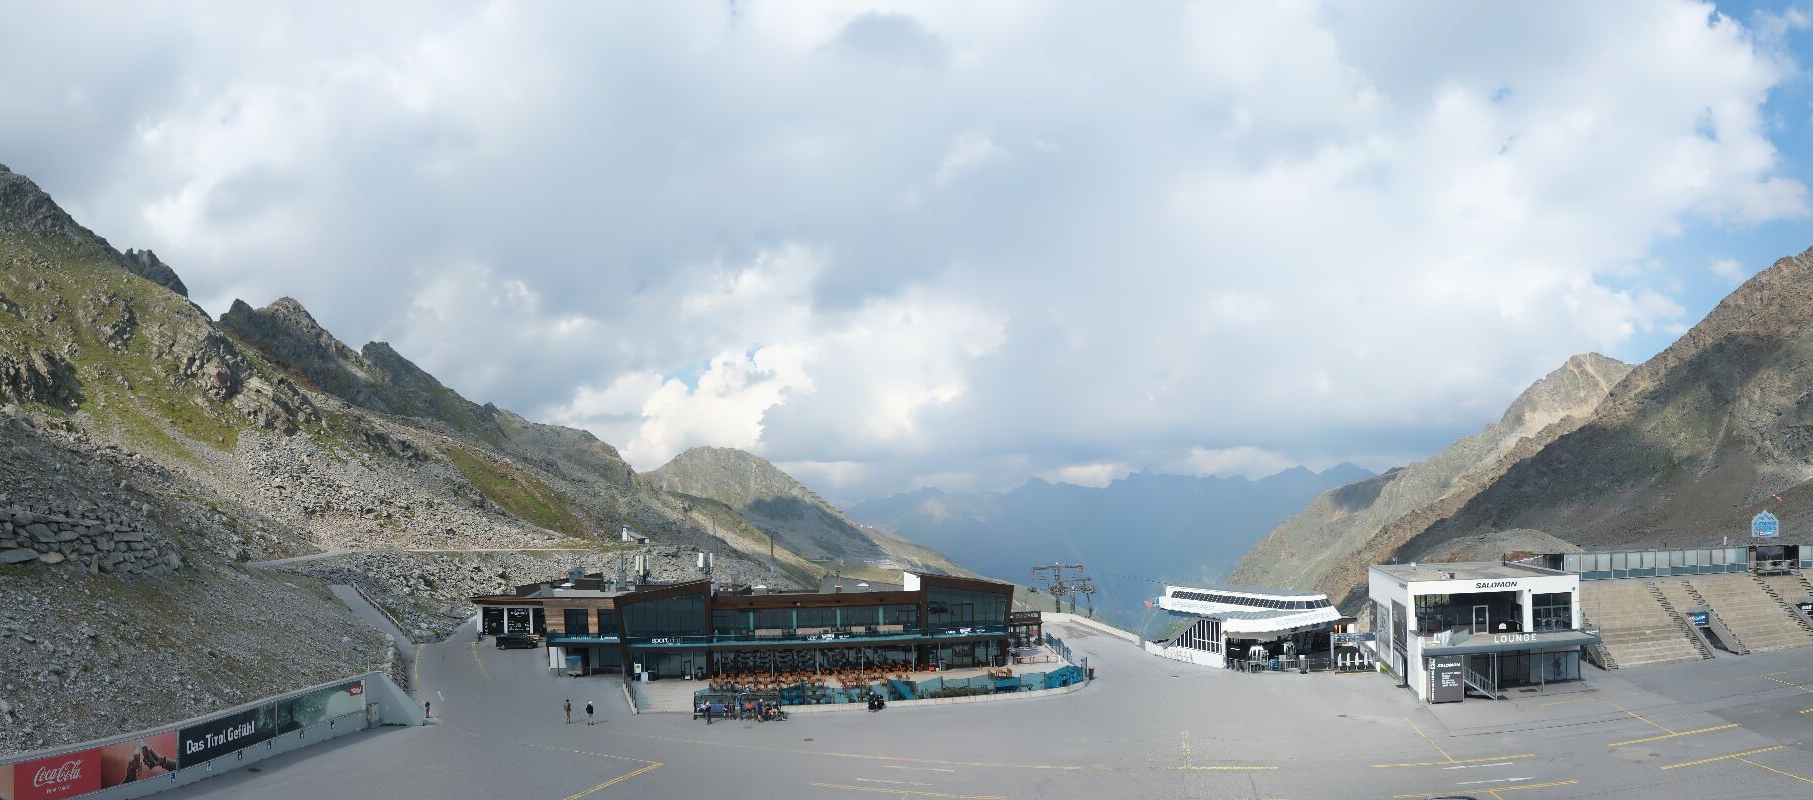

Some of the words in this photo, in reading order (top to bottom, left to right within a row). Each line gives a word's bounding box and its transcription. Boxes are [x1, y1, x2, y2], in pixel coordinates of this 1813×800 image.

[1475, 581, 1518, 589] SALOMON
[1494, 633, 1537, 643] LOUNGE
[186, 739, 205, 755] Das
[206, 729, 227, 748] Tirol
[228, 720, 255, 742] Gefühl
